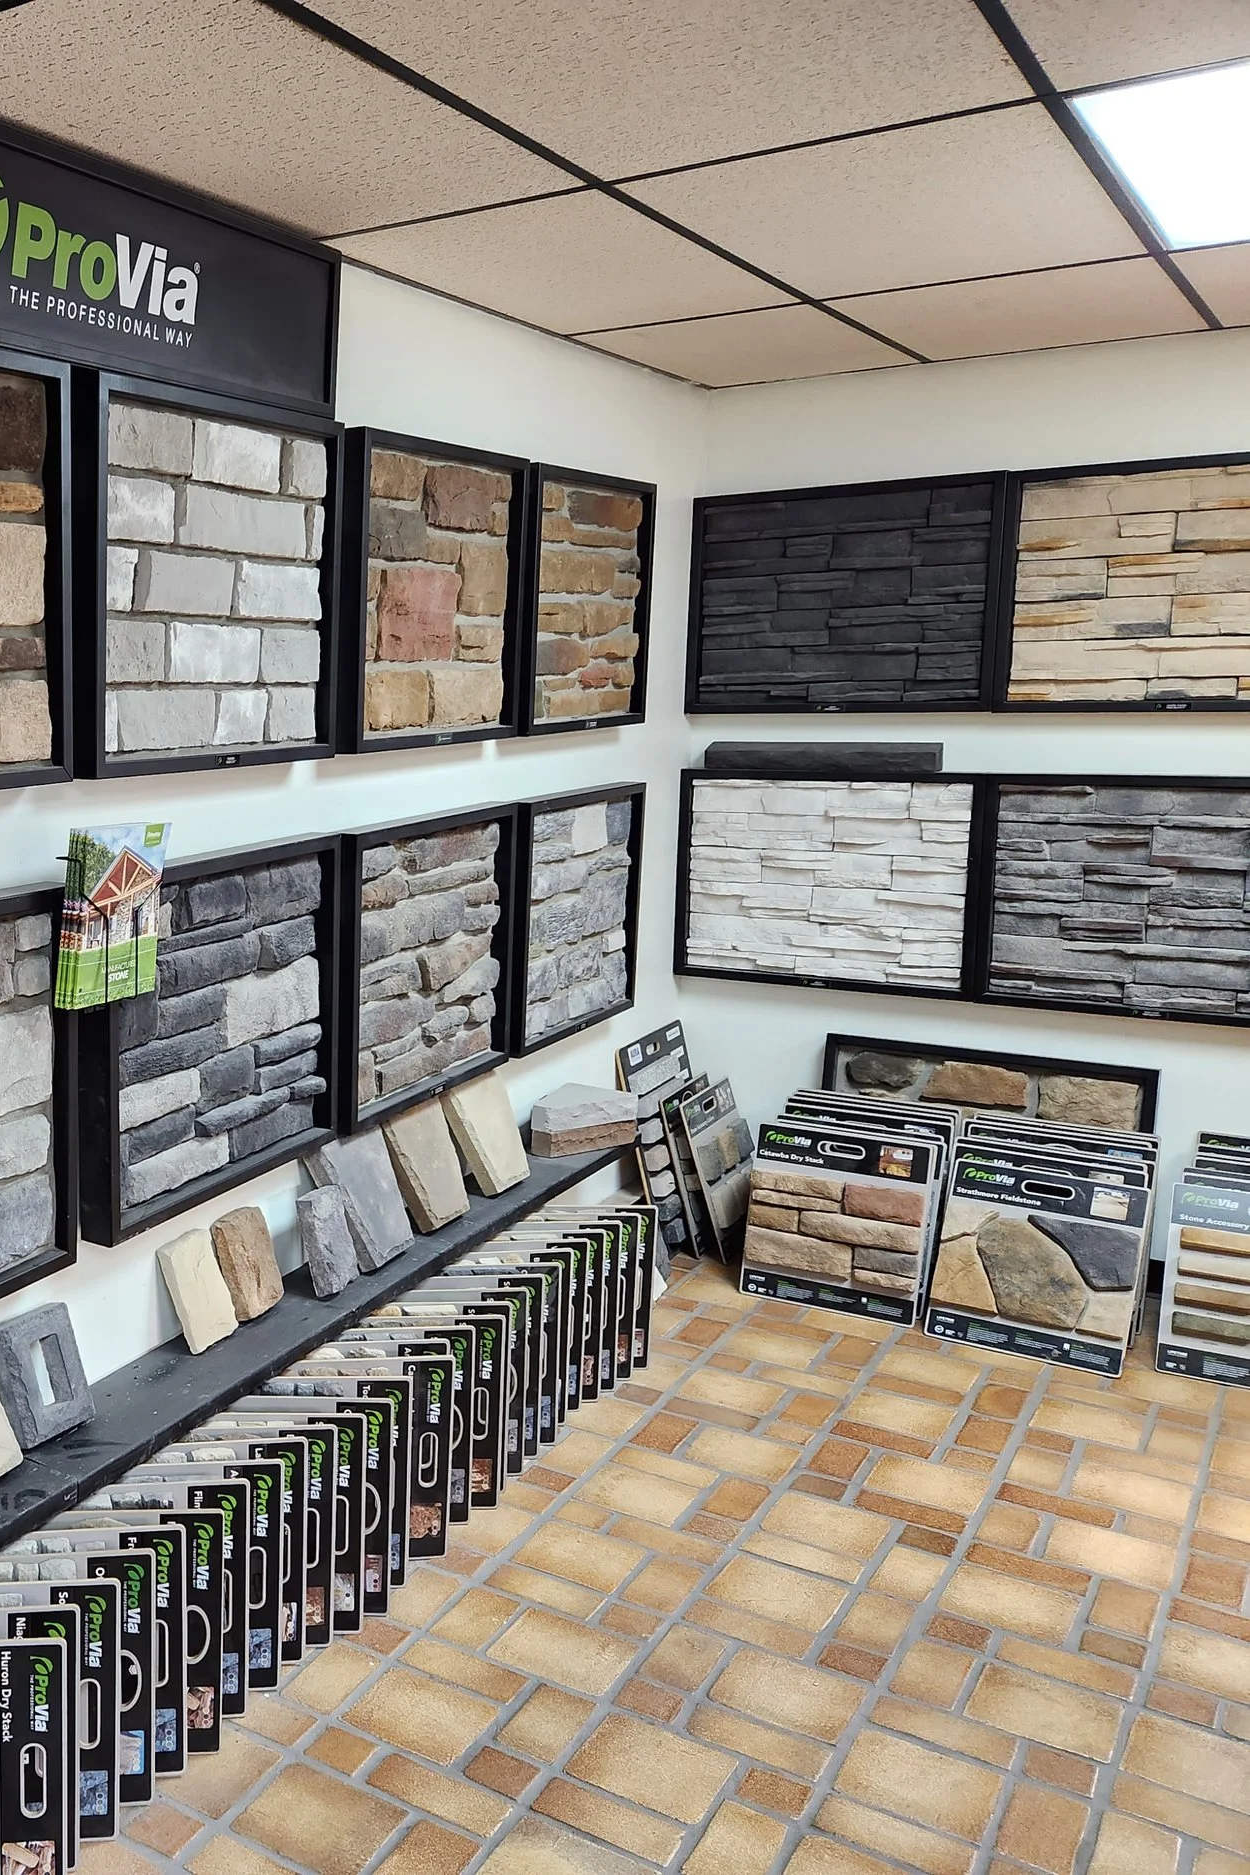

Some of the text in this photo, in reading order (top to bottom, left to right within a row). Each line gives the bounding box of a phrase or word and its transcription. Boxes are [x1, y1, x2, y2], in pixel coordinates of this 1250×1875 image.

[10, 286, 194, 348] THE PROFESSIONAL WAY
[108, 970, 129, 983] STONE
[759, 1149, 824, 1164] Catawba Dry Stack
[777, 1134, 812, 1146] ProVia
[956, 1186, 1041, 1206] Strathmore Fieldstone
[976, 1172, 1016, 1184] ProVia
[1179, 1214, 1250, 1230] Stone Accessory
[1196, 1196, 1239, 1209] ProVia
[430, 1382, 441, 1423] ProVia
[338, 1442, 350, 1487] ProVia
[368, 1424, 379, 1469] ProVia
[310, 1454, 322, 1499] ProVia
[257, 1490, 269, 1537] ProVia
[157, 1556, 170, 1608] ProVia
[197, 1539, 209, 1590] ProVia
[127, 1581, 141, 1634] ProVia
[89, 1613, 102, 1668] ProVia
[0, 1651, 13, 1742] Huron Dry Stack
[35, 1675, 49, 1732] ProVia
